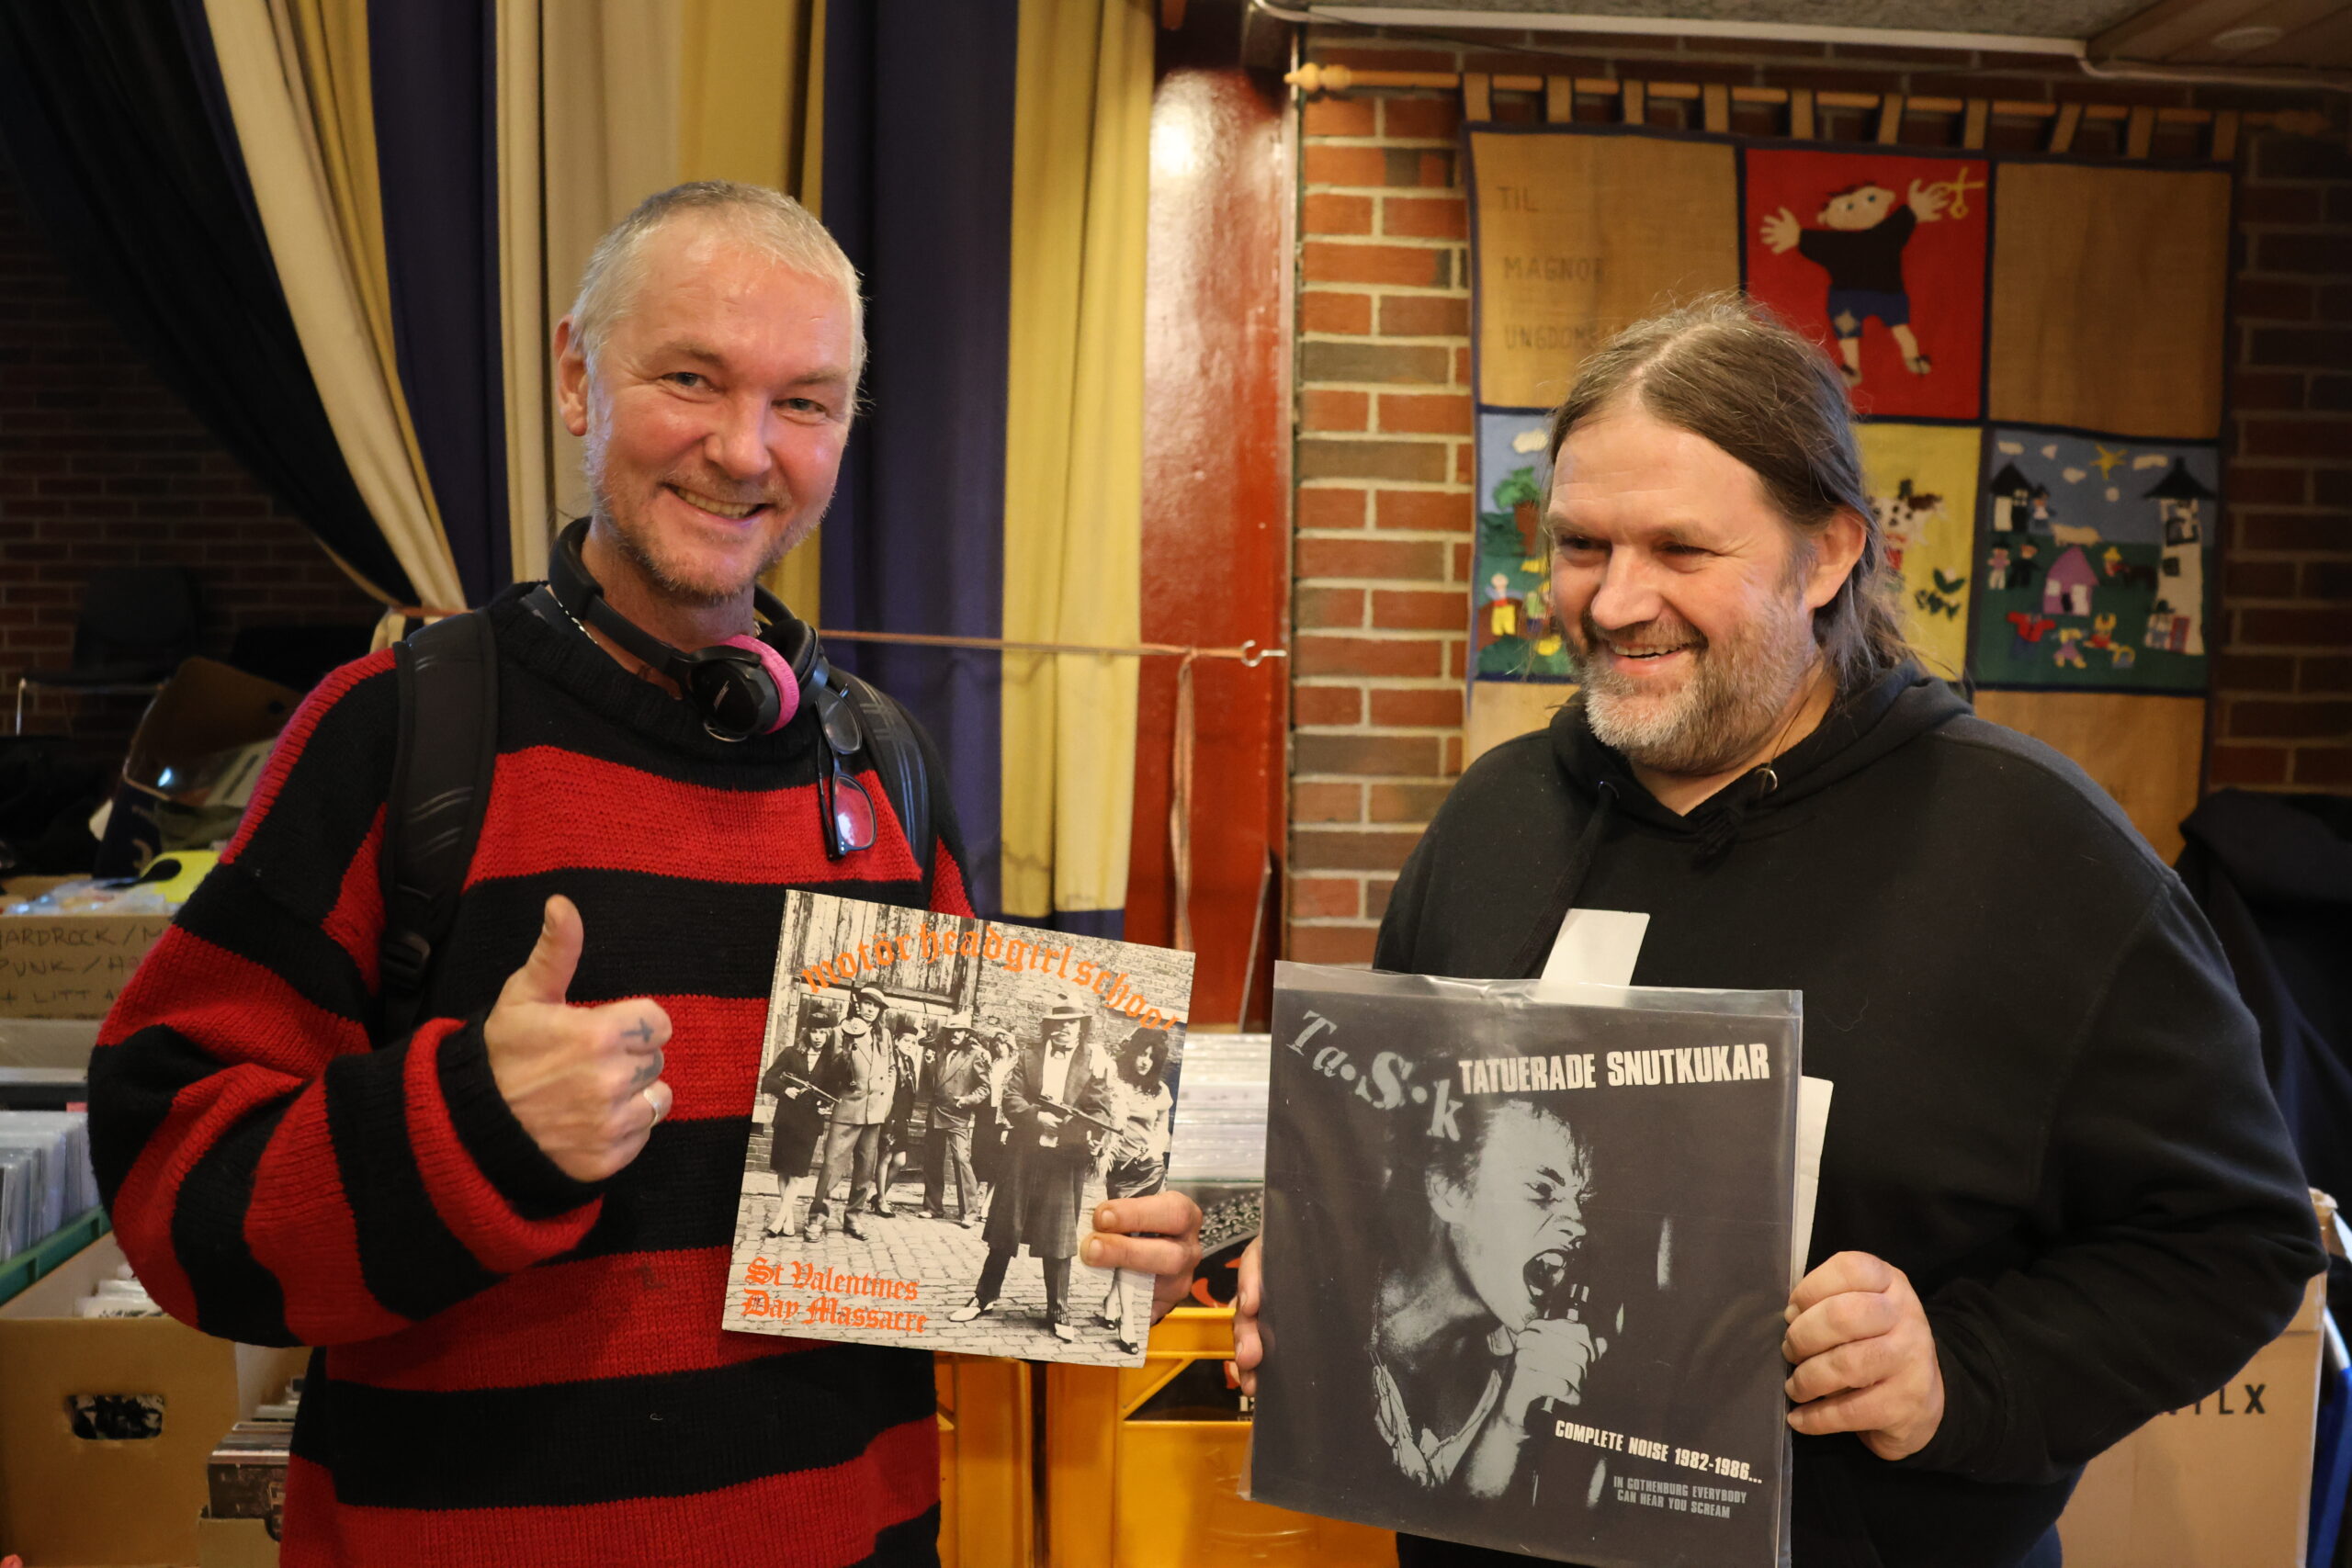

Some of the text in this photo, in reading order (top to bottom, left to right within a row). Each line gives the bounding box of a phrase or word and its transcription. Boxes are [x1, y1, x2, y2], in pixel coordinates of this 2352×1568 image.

[1497, 186, 1539, 213] TIL
[33, 989, 91, 1004] LITT
[1458, 1043, 1770, 1095] TATUERADE SNUTKUKAR
[744, 1256, 921, 1302] St Valentines
[741, 1288, 929, 1334] Day Massacre
[1555, 1420, 1763, 1484] COMPLETE NOISE 1982-1986...
[1613, 1475, 1747, 1505] IN GOTHENBURG EVERYBODY
[1617, 1489, 1731, 1519] CAN HEAR YOU SCREAM
